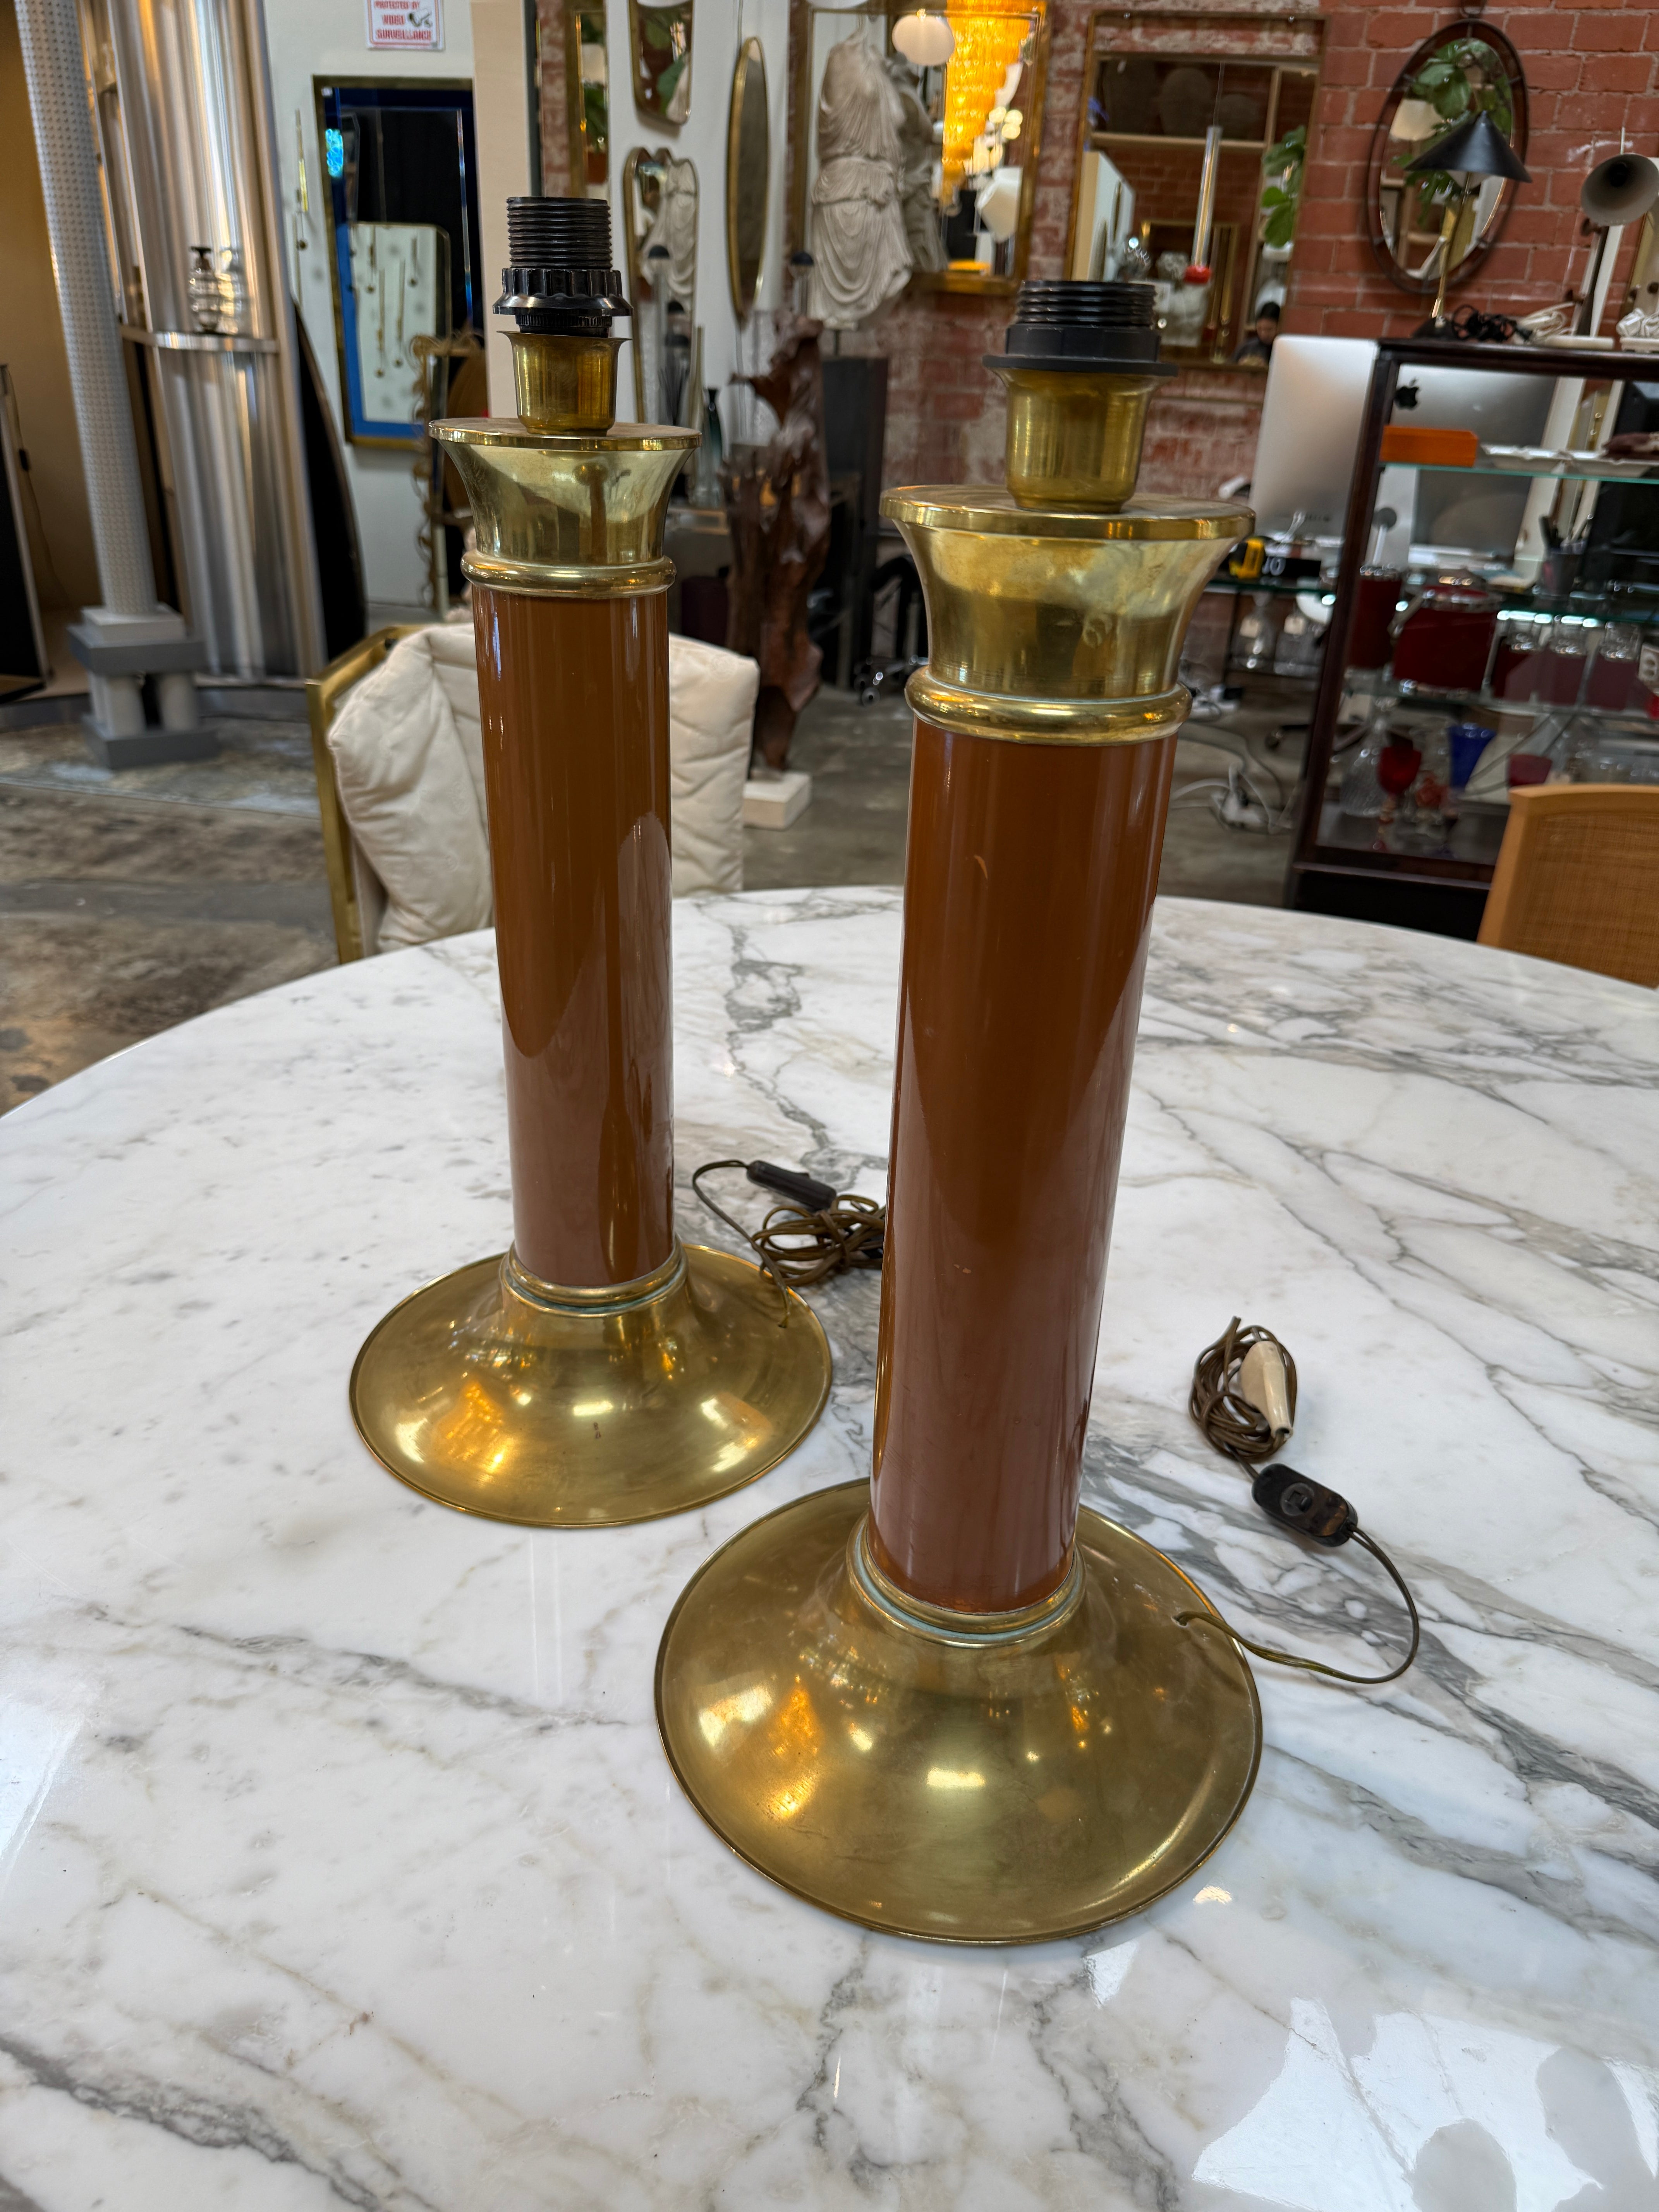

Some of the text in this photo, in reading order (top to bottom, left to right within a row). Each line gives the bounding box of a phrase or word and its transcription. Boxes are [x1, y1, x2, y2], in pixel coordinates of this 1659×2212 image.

[374, 1, 409, 9] PROTECTED
[382, 14, 405, 25] VIDEO
[376, 29, 431, 40] SURVEILLANCE
